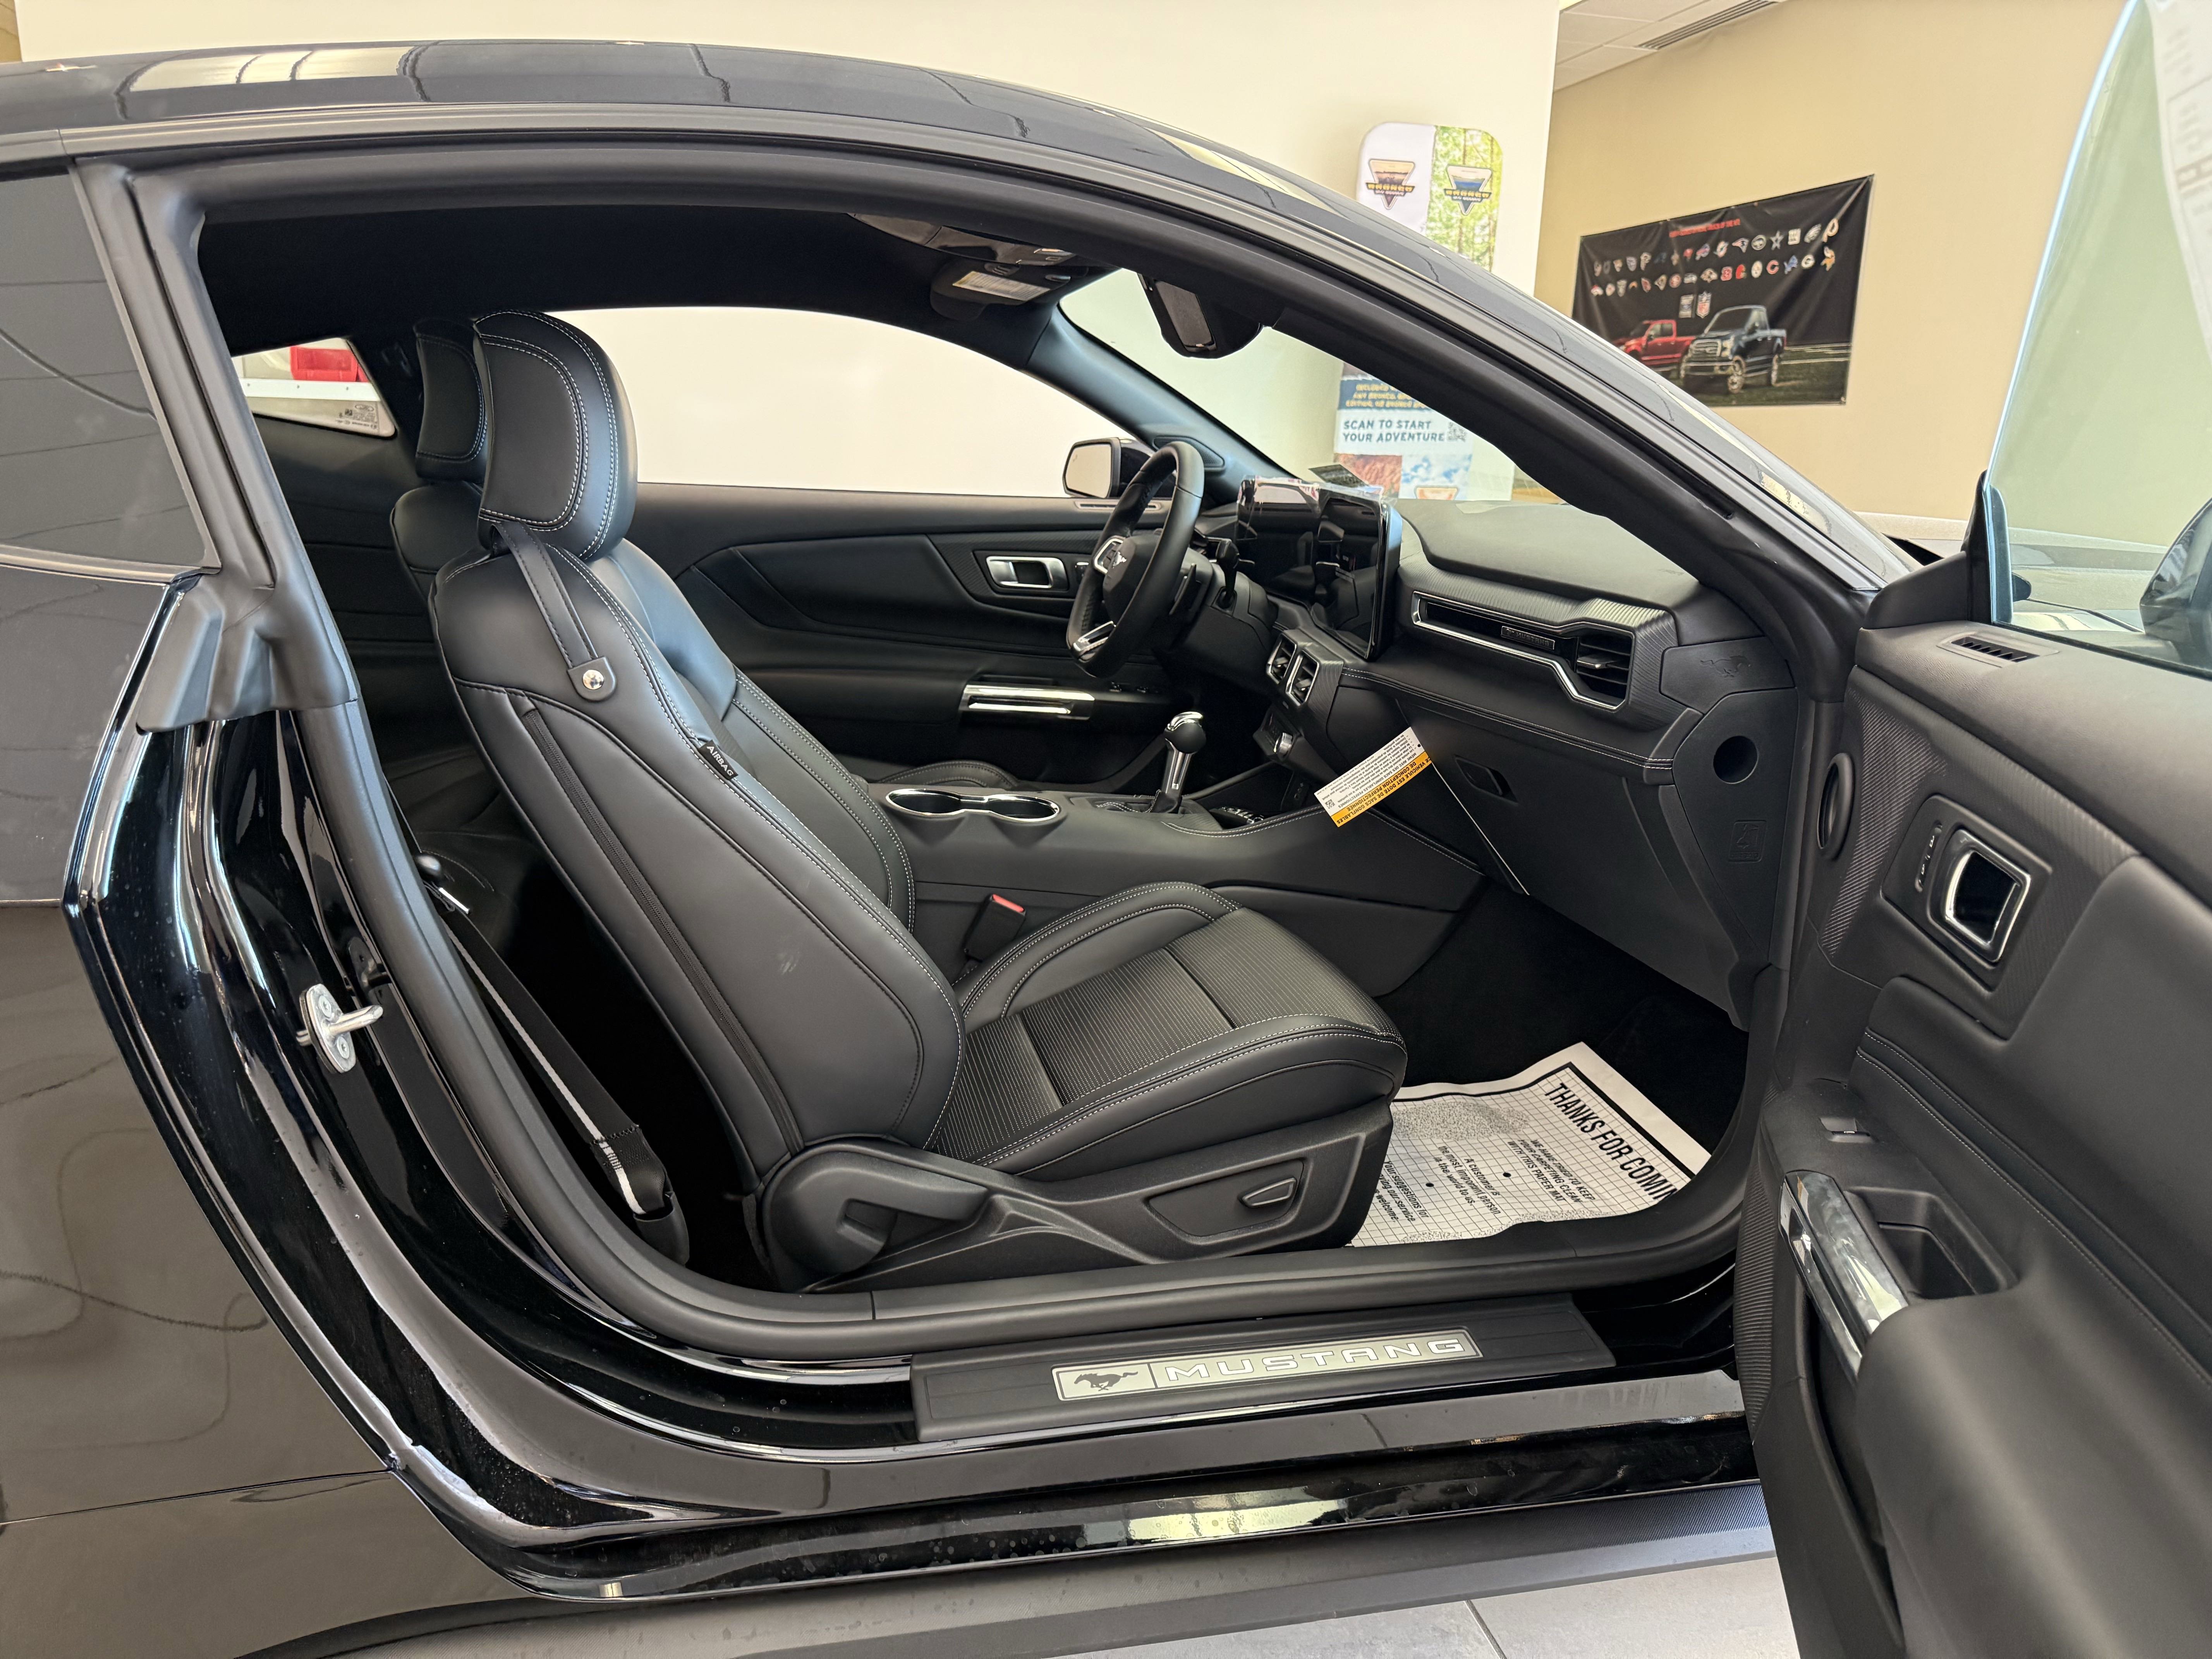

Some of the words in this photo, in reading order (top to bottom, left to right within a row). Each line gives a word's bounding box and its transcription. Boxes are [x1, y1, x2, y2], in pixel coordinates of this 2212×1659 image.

[1343, 433, 1372, 442] YOUR
[1376, 432, 1444, 442] ADVENTURE
[1344, 420, 1374, 429] SCAN
[1379, 420, 1393, 429] TO
[1397, 421, 1431, 429] START
[707, 746, 733, 776] AIRBAG
[1405, 762, 1425, 778] VÉHICULE
[1382, 767, 1410, 788] CONCEPTION
[1384, 783, 1396, 793] DOTÉ
[1396, 777, 1405, 785] EST
[1346, 786, 1382, 811] PERFECTIONNÉE
[1365, 796, 1377, 806] SACS
[1545, 1083, 1605, 1133] THANKS
[1590, 1130, 1633, 1160] FOR
[1439, 1163, 1450, 1173] the
[1447, 1174, 1465, 1188] world
[1465, 1196, 1475, 1206] us.
[1446, 1154, 1463, 1168] most
[1458, 1169, 1485, 1195] important
[1477, 1195, 1501, 1214] person
[1469, 1164, 1495, 1190] customer
[1508, 1141, 1525, 1154] WITH
[1521, 1155, 1537, 1168] THIS
[1532, 1170, 1554, 1189] PAPER
[1549, 1190, 1566, 1201] MAT
[1518, 1139, 1536, 1153] YOUR
[1532, 1154, 1565, 1183] CARPETING
[1559, 1185, 1583, 1202] CLEAN
[1530, 1139, 1544, 1149] WE
[1539, 1149, 1557, 1161] HAVE
[1553, 1163, 1573, 1178] TRIED
[1576, 1186, 1595, 1200] KEEP
[1384, 1161, 1396, 1174] Your
[1392, 1175, 1421, 1209] suggestions
[1388, 1190, 1400, 1199] our
[1395, 1200, 1415, 1221] service
[1165, 1338, 1465, 1381] MUSTANG
